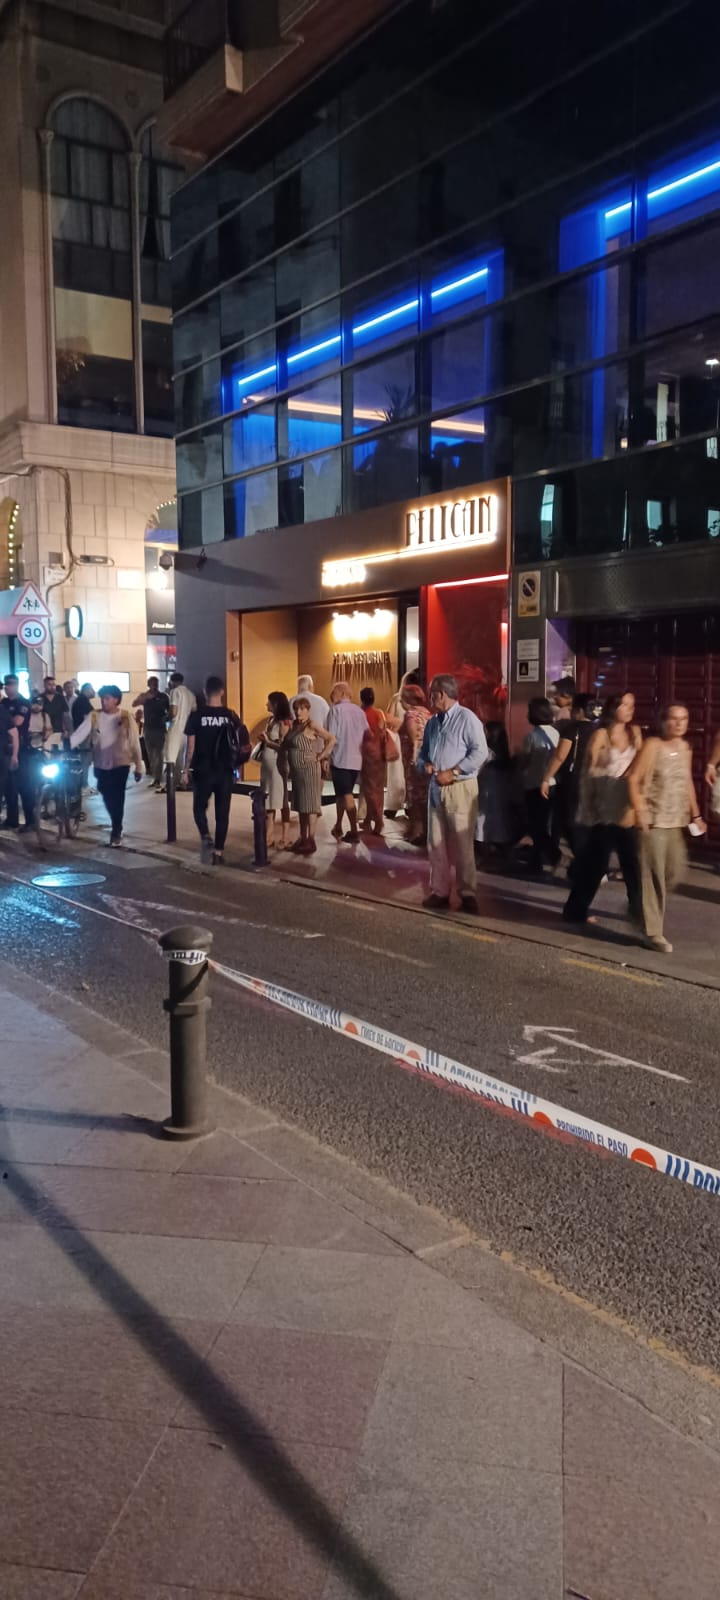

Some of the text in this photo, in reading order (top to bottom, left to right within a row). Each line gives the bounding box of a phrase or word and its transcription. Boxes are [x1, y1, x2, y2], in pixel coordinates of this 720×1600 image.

[405, 495, 492, 547] PELICAN
[24, 627, 42, 638] 30
[607, 1137, 628, 1157] PASO
